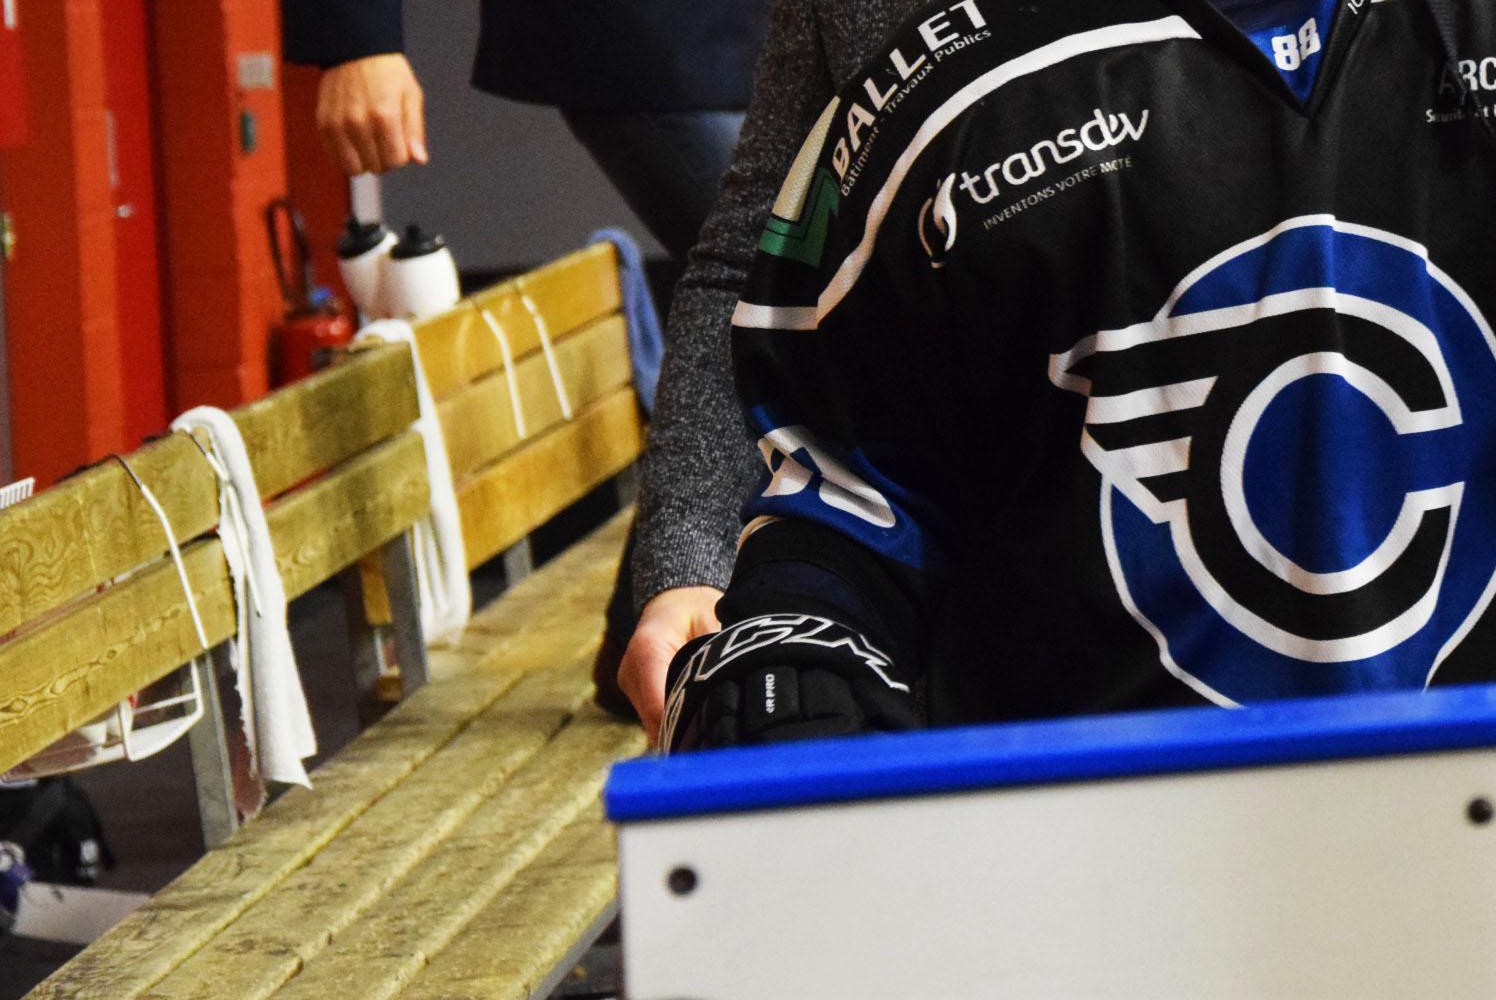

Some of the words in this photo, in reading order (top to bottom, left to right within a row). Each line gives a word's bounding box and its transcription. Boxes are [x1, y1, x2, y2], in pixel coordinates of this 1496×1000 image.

[884, 62, 935, 114] Travaux
[934, 29, 992, 63] Publics
[1270, 16, 1322, 72] 88
[982, 186, 1056, 231] INVENTONS
